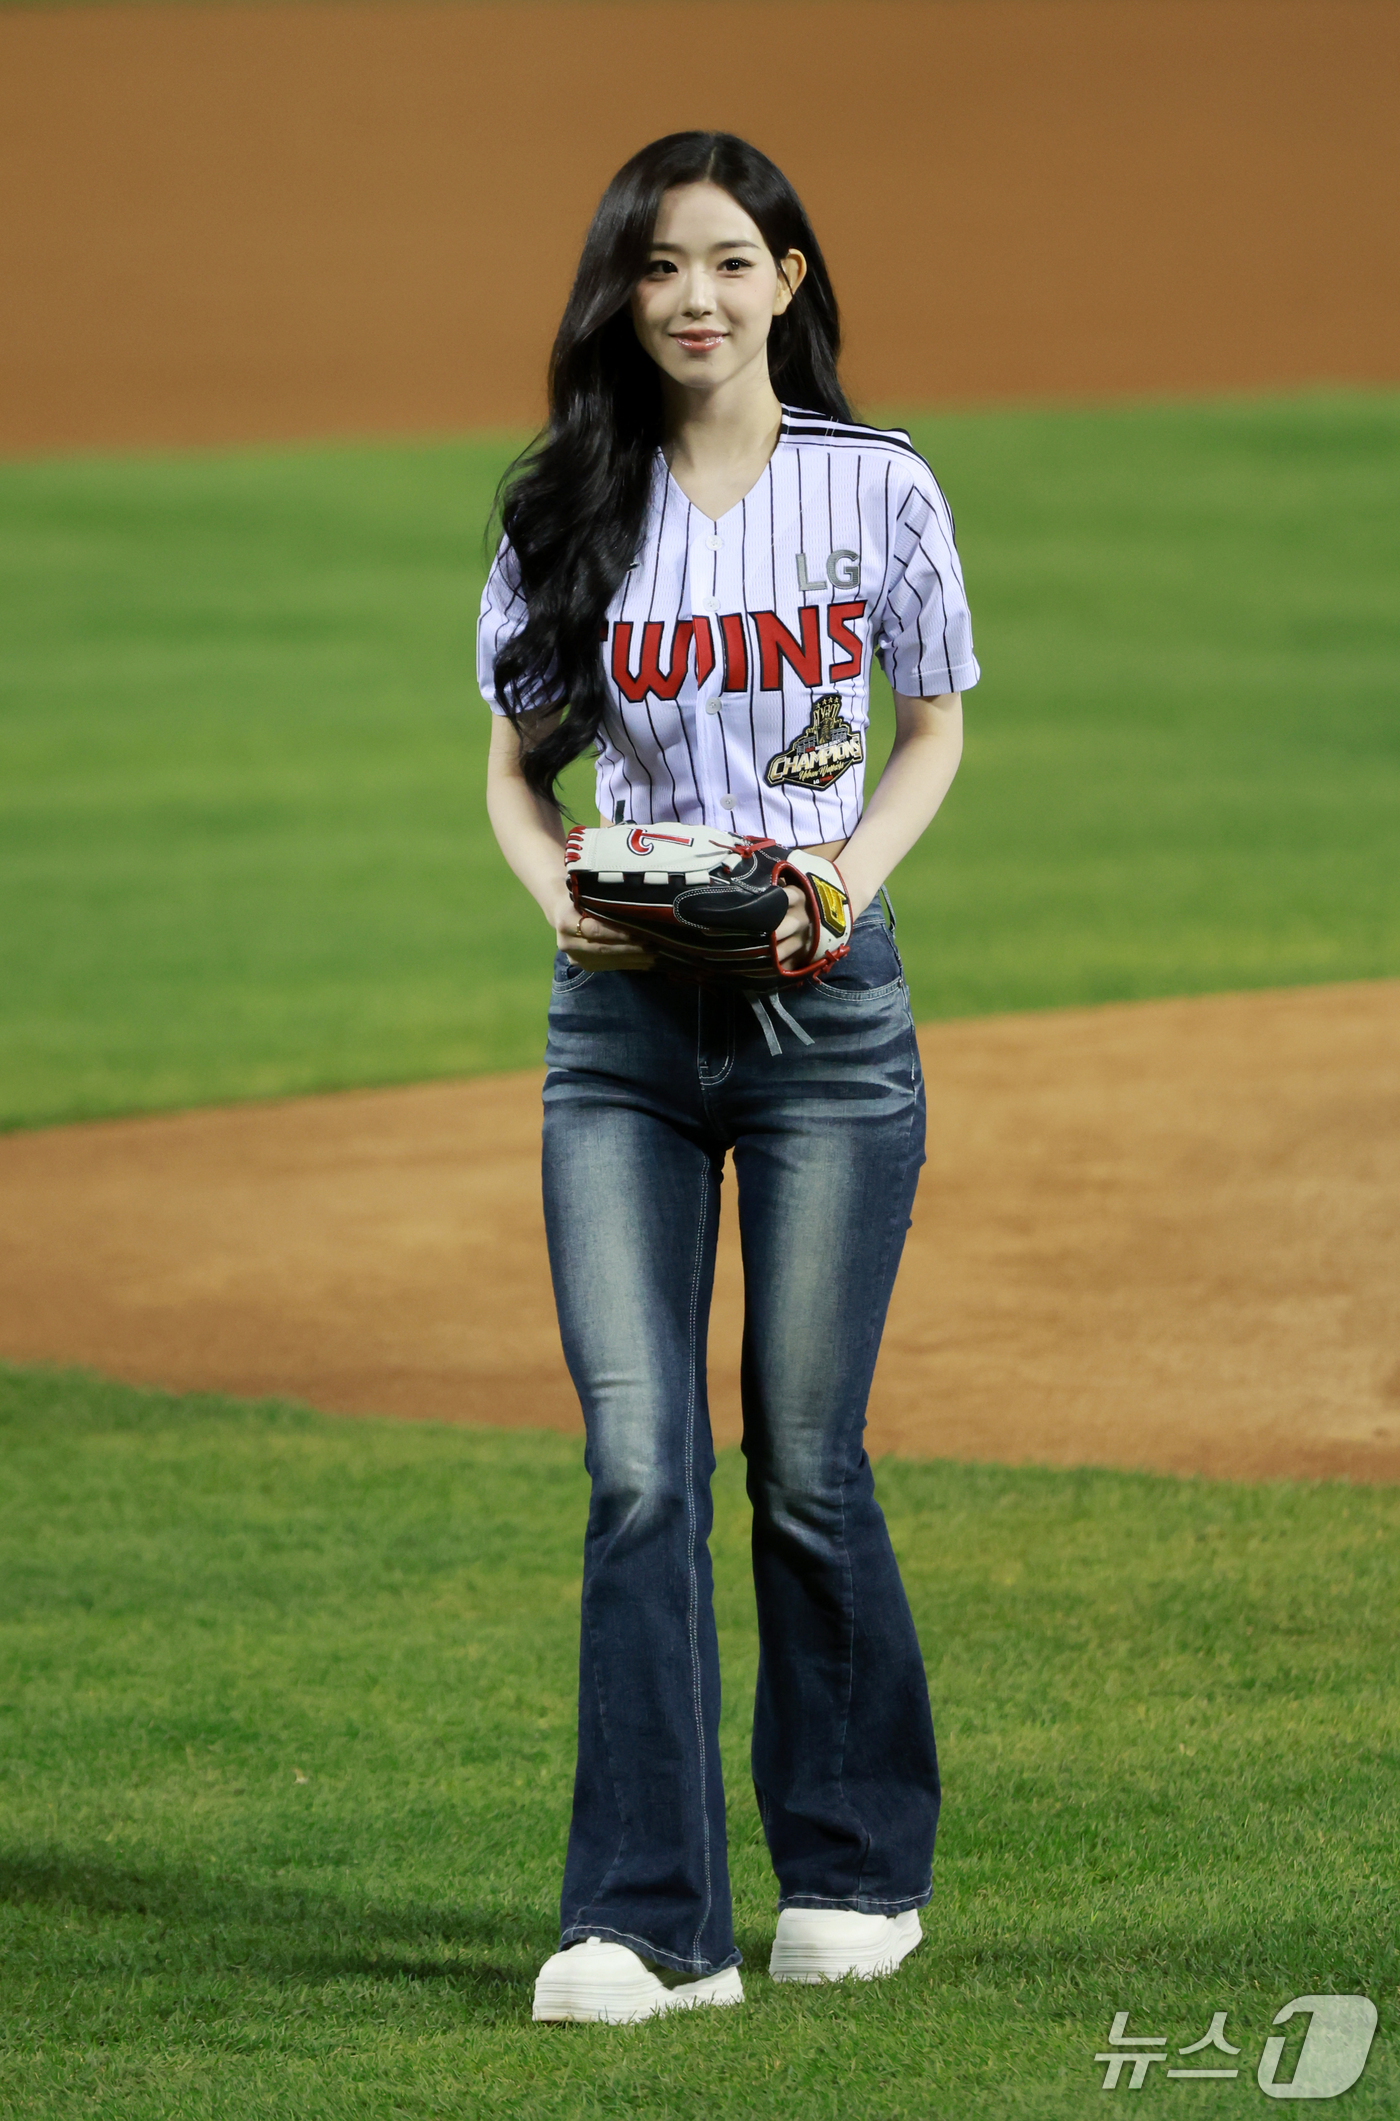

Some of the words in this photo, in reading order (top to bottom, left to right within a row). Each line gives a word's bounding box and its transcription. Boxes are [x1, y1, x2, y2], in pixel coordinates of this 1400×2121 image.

[795, 549, 860, 592] LG
[600, 600, 868, 703] WINS
[771, 734, 861, 780] CHAMPIONS
